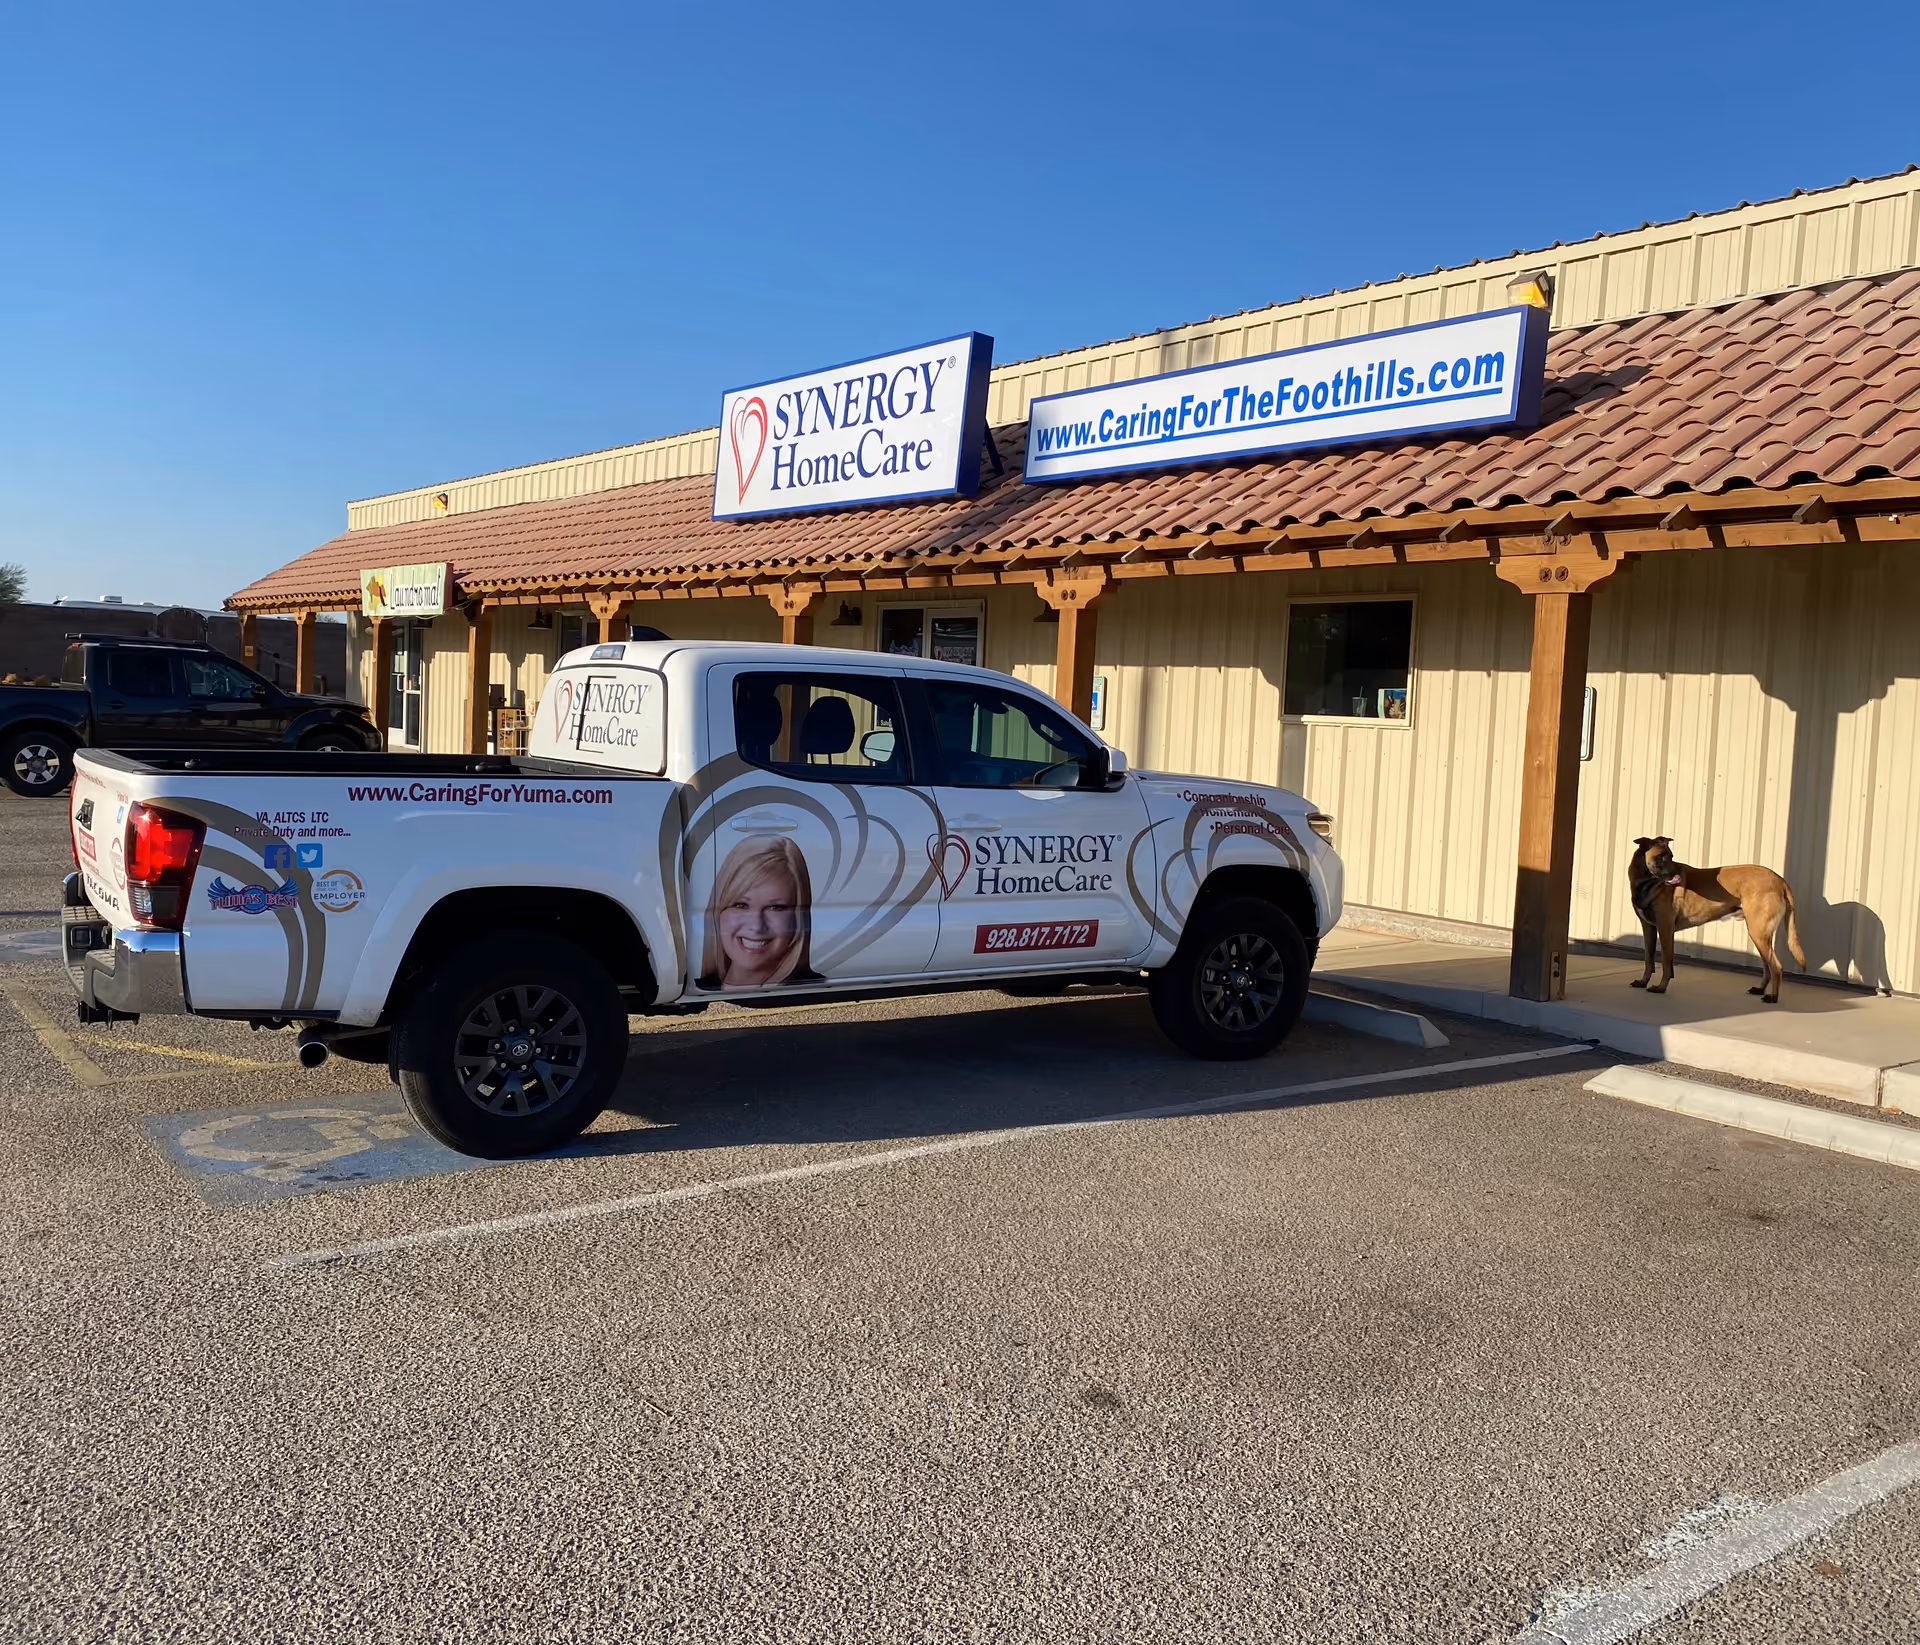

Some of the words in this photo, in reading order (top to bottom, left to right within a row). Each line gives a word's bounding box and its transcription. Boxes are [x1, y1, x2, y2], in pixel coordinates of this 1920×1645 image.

[1036, 350, 1505, 453] www.CaringForTheFoothills.com
[770, 428, 933, 491] HomeCare
[390, 566, 441, 610] Laundromat
[568, 713, 639, 747] HomeCare
[348, 783, 613, 805] www.CaringForYuma.com
[1183, 790, 1266, 808] Companionship
[256, 812, 271, 825] VA,
[274, 812, 306, 824] ALTCS
[311, 812, 329, 824] LTC
[1214, 821, 1264, 835] Personal
[1267, 822, 1290, 836] Care
[234, 826, 269, 838] Private
[272, 826, 296, 840] Duty
[298, 825, 316, 837] and
[974, 865, 1113, 895] HomeCare
[313, 891, 366, 900] EMPLOYER
[985, 924, 1091, 949] 928.817.7172
